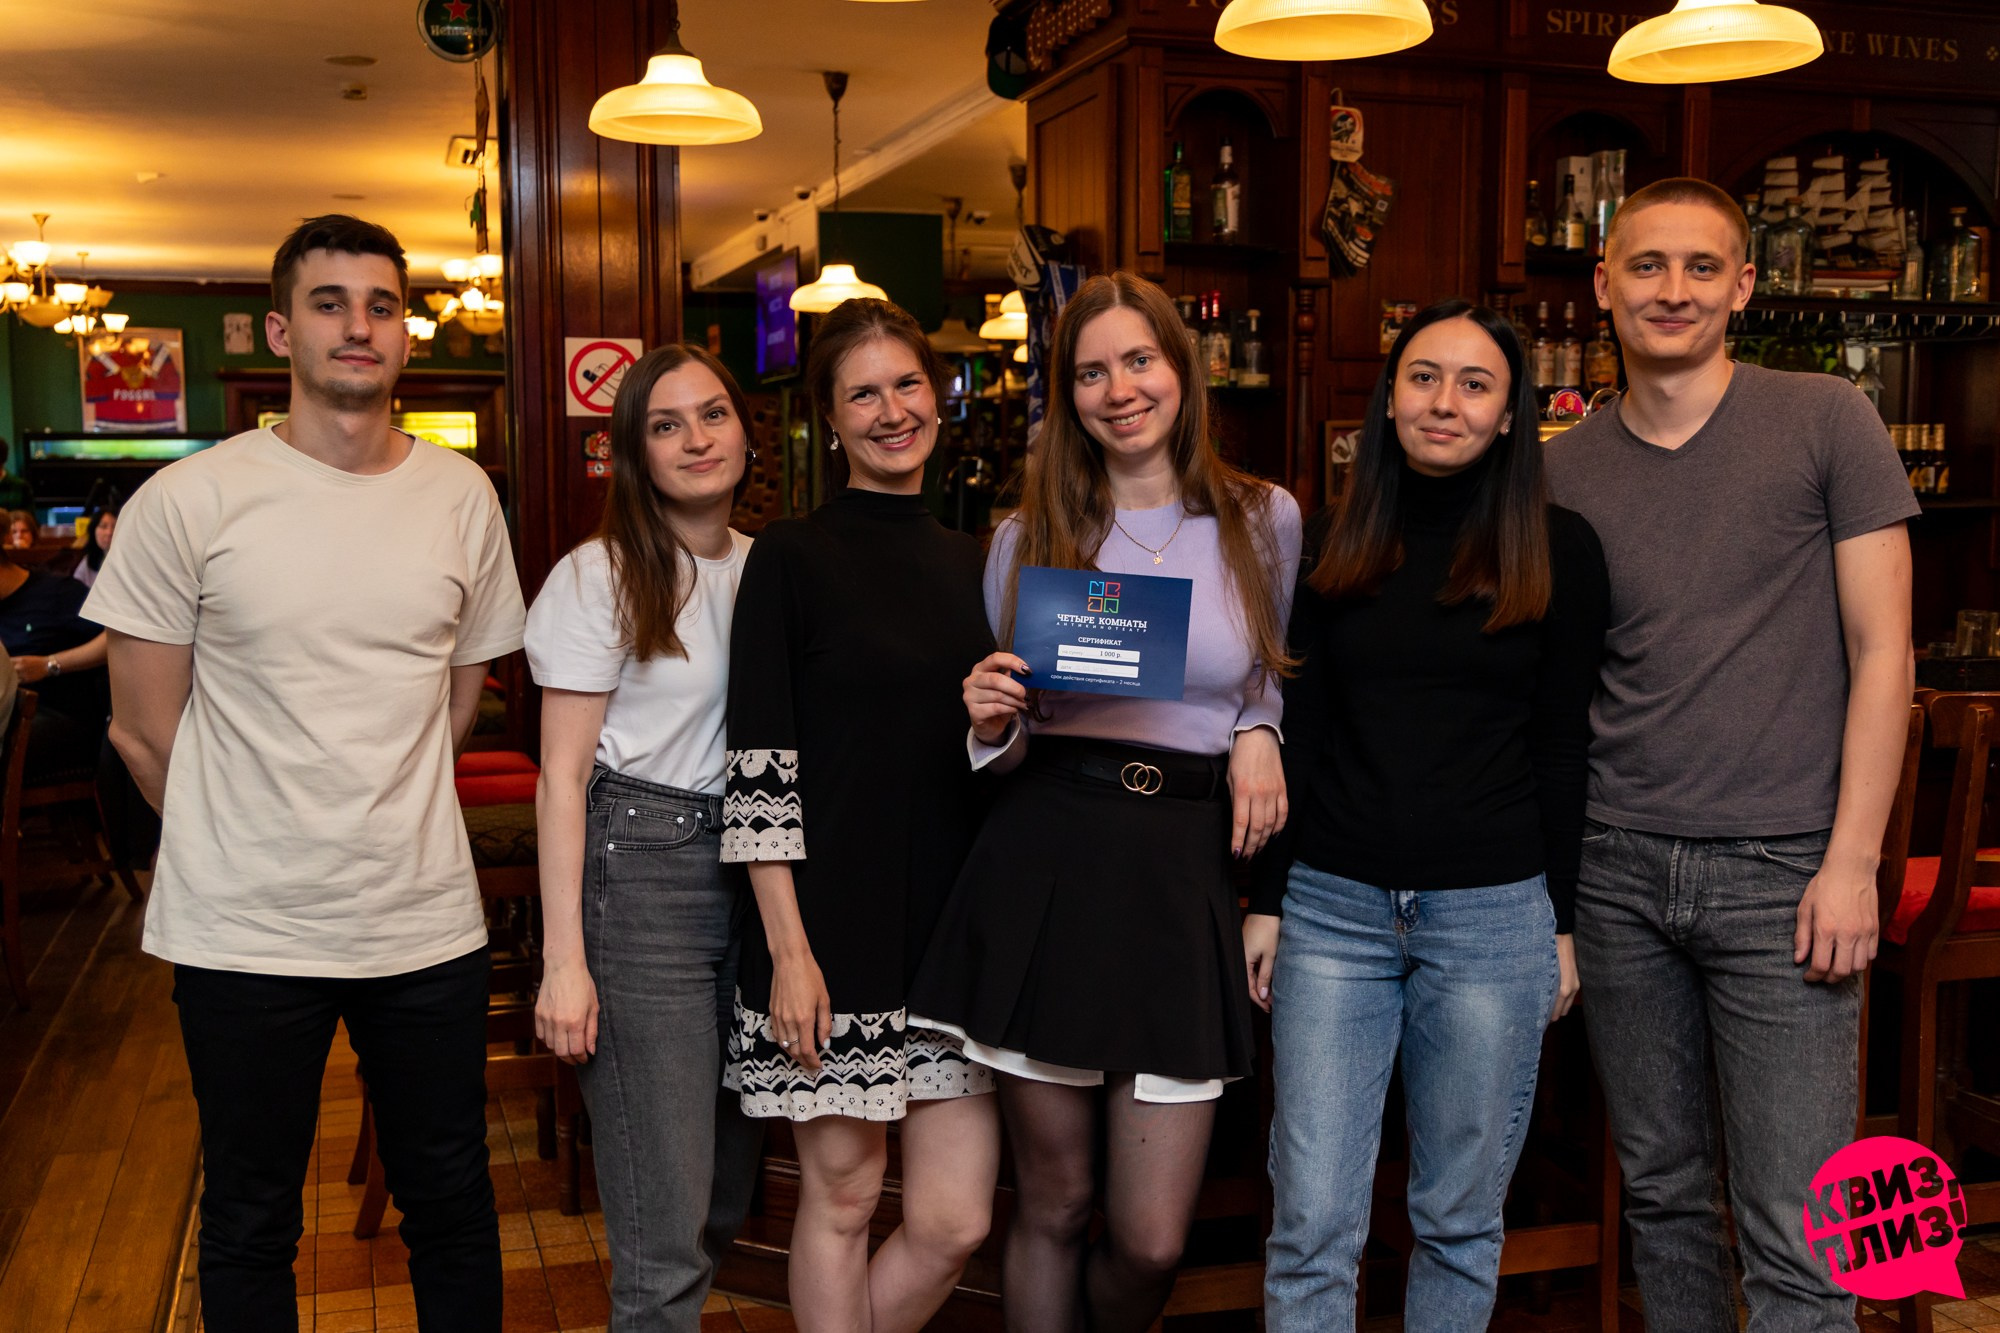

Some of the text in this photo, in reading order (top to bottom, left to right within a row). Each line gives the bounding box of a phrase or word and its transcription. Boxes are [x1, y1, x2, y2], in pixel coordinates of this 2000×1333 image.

[1821, 30, 1959, 63] NE WINES
[1057, 614, 1147, 628] ЧЕТЫРЕ КОМНАТЫ
[1078, 637, 1122, 645] СЕРТИФИКАТ
